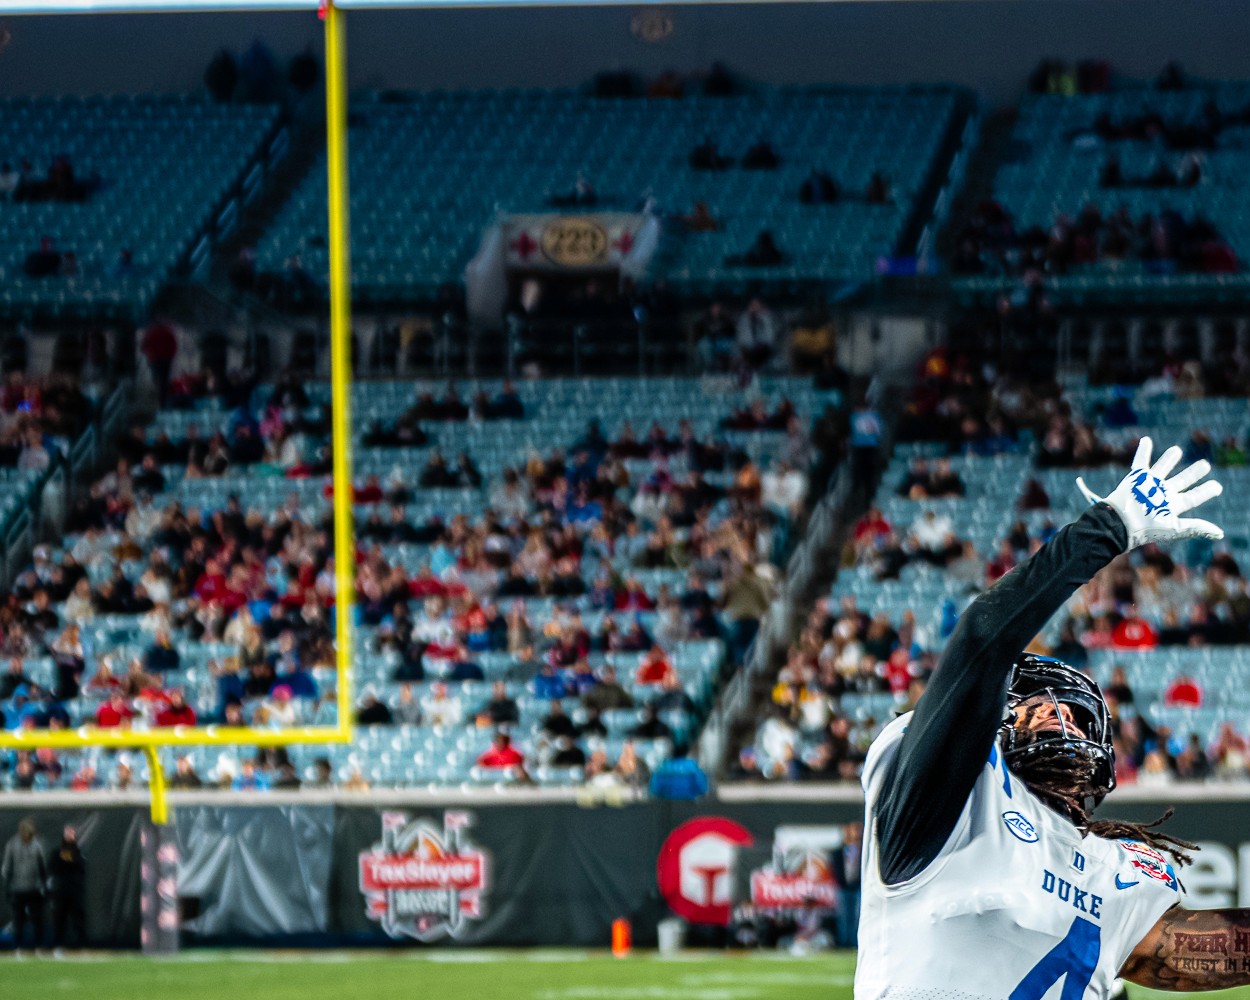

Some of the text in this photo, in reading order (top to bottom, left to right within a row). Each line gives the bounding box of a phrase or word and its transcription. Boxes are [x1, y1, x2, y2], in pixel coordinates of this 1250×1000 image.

[1008, 817, 1034, 838] ACC
[371, 860, 475, 883] TaxSlayer
[1041, 868, 1103, 919] DUKE
[1172, 957, 1220, 972] TRUST
[1224, 956, 1238, 973] IN
